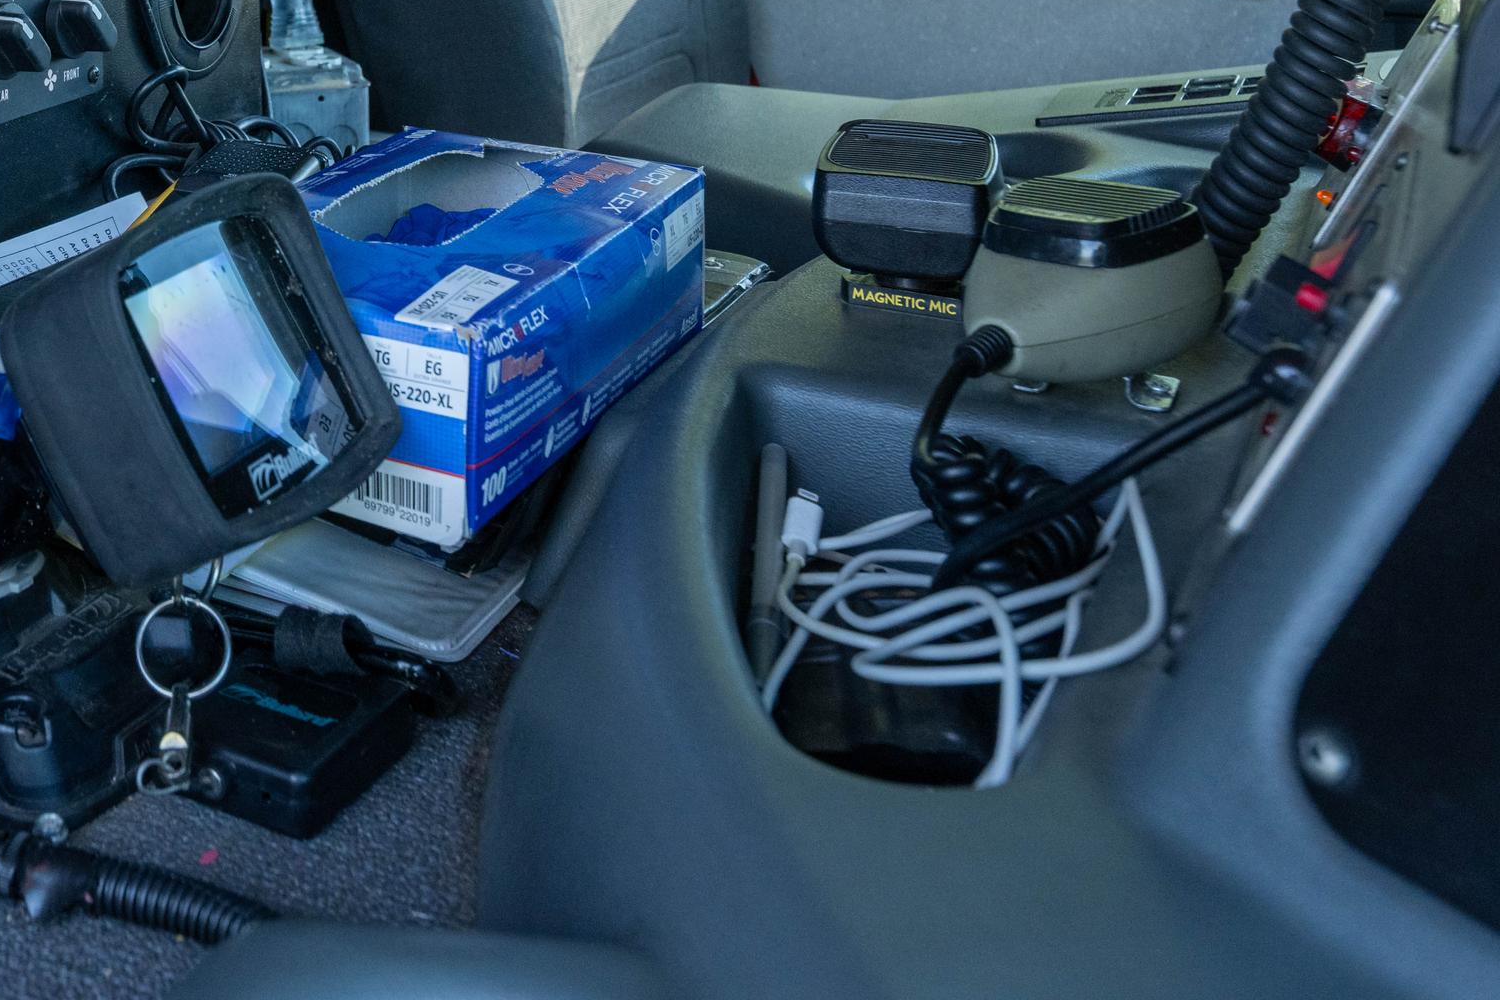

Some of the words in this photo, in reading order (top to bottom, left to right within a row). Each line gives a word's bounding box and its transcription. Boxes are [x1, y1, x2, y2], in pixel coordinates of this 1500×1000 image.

[63, 66, 80, 83] FRONT
[852, 287, 926, 310] MAGNETIC
[928, 299, 957, 315] MIC
[375, 349, 391, 366] TG
[425, 360, 442, 376] EG
[481, 466, 507, 507] 100
[364, 499, 396, 517] 69799
[400, 510, 431, 528] 22019
